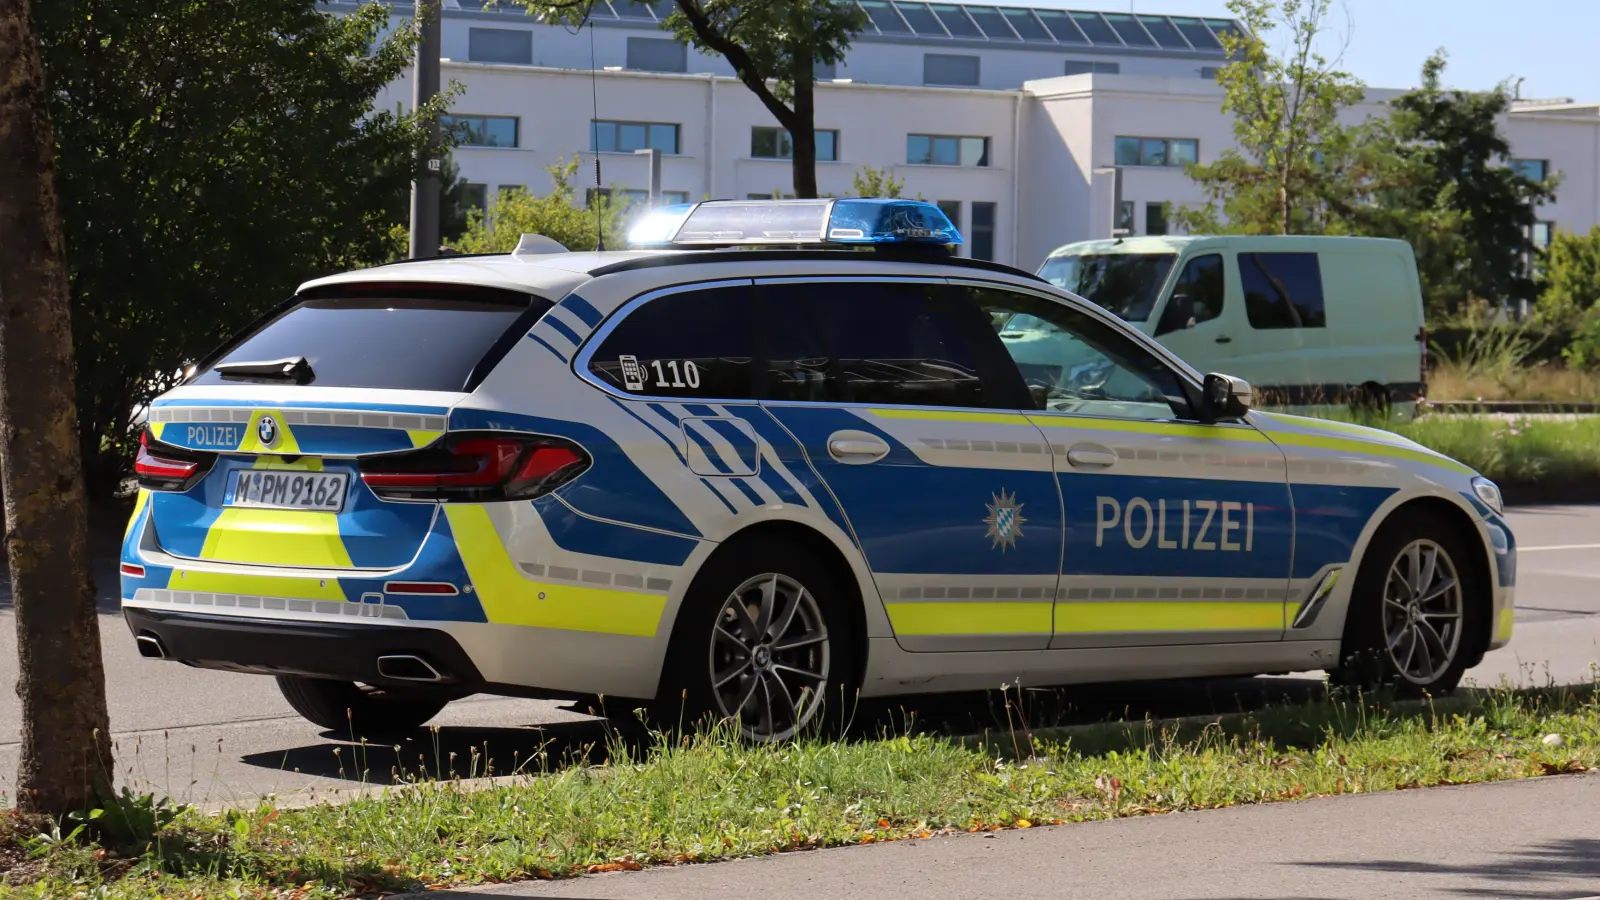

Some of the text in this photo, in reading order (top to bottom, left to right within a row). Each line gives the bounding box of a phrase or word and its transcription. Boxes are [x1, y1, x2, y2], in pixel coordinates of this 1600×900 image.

[651, 360, 700, 388] 110
[187, 426, 238, 446] POLIZEI
[234, 473, 342, 506] M PM 9162
[1095, 496, 1254, 552] POLIZEI
